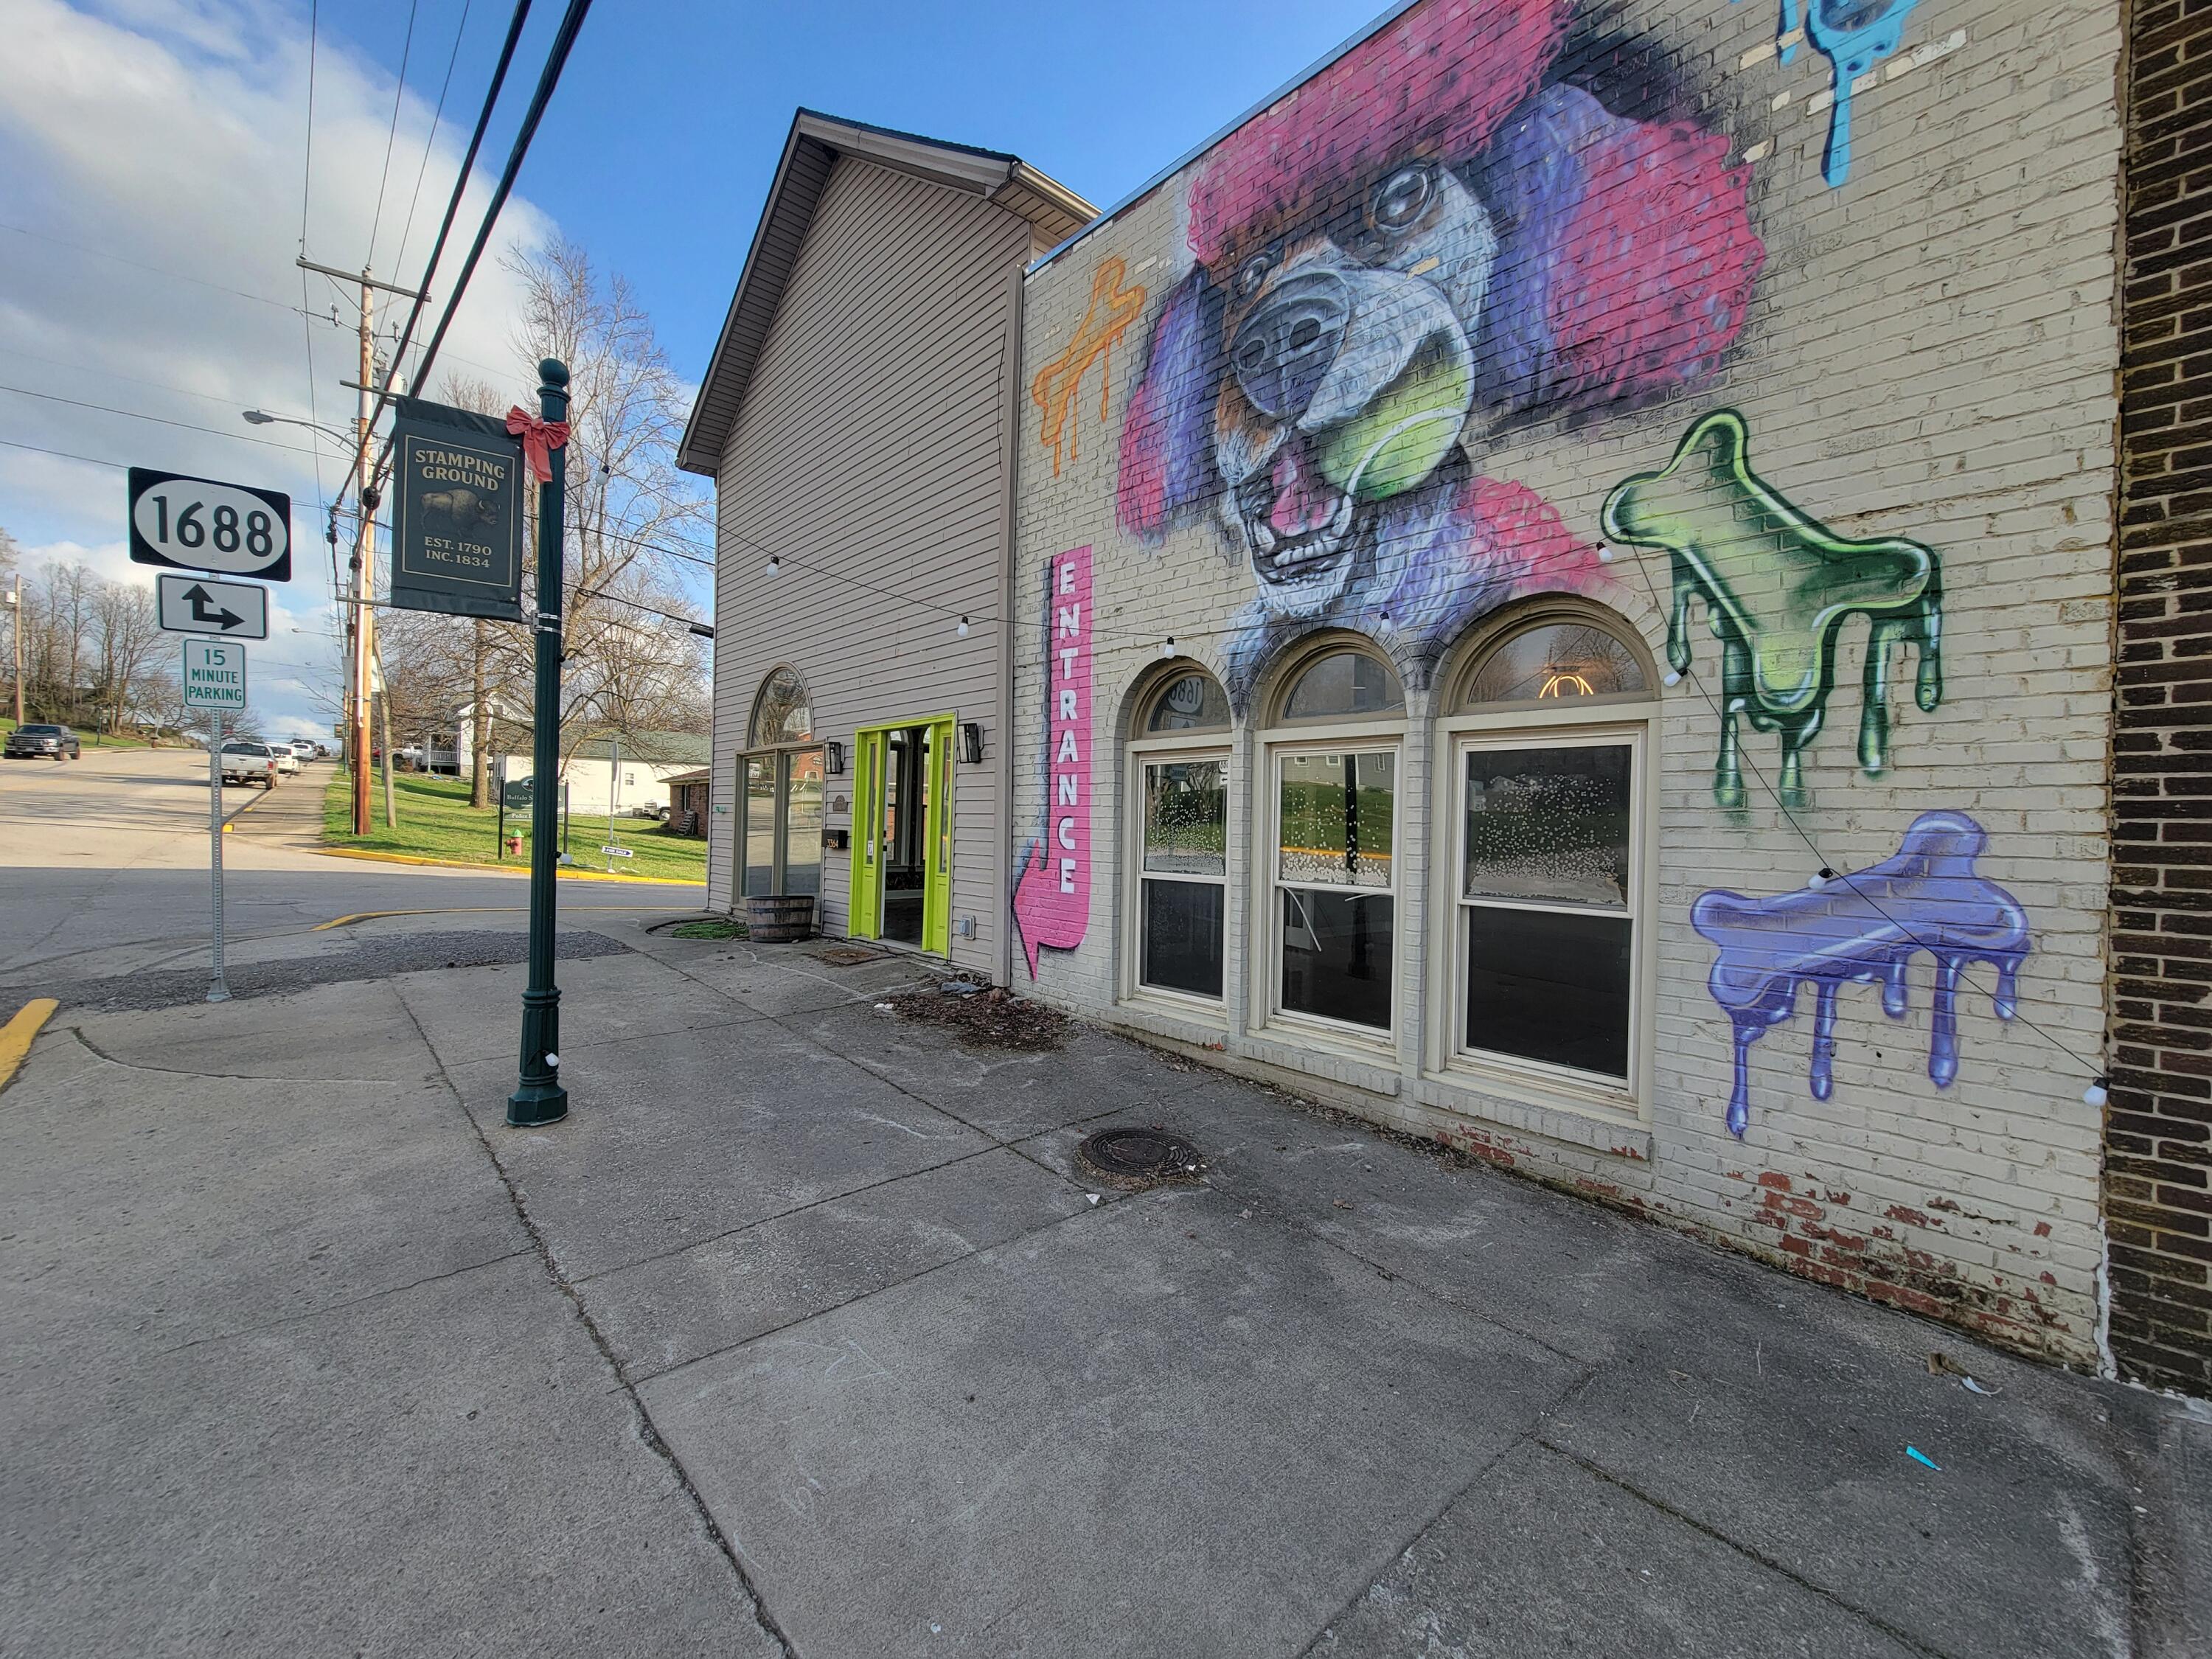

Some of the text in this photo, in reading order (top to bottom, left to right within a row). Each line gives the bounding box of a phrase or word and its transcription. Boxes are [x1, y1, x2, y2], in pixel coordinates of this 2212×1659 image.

[415, 450, 504, 479] STAMPING
[422, 466, 498, 491] GROUND
[152, 495, 273, 557] 1688
[424, 536, 492, 556] EST. 1790
[425, 549, 490, 568] INC. 1834
[205, 649, 226, 666] 15
[192, 668, 239, 684] MINUTE
[189, 686, 243, 701] PARKING
[1057, 561, 1080, 894] ENTRANCE
